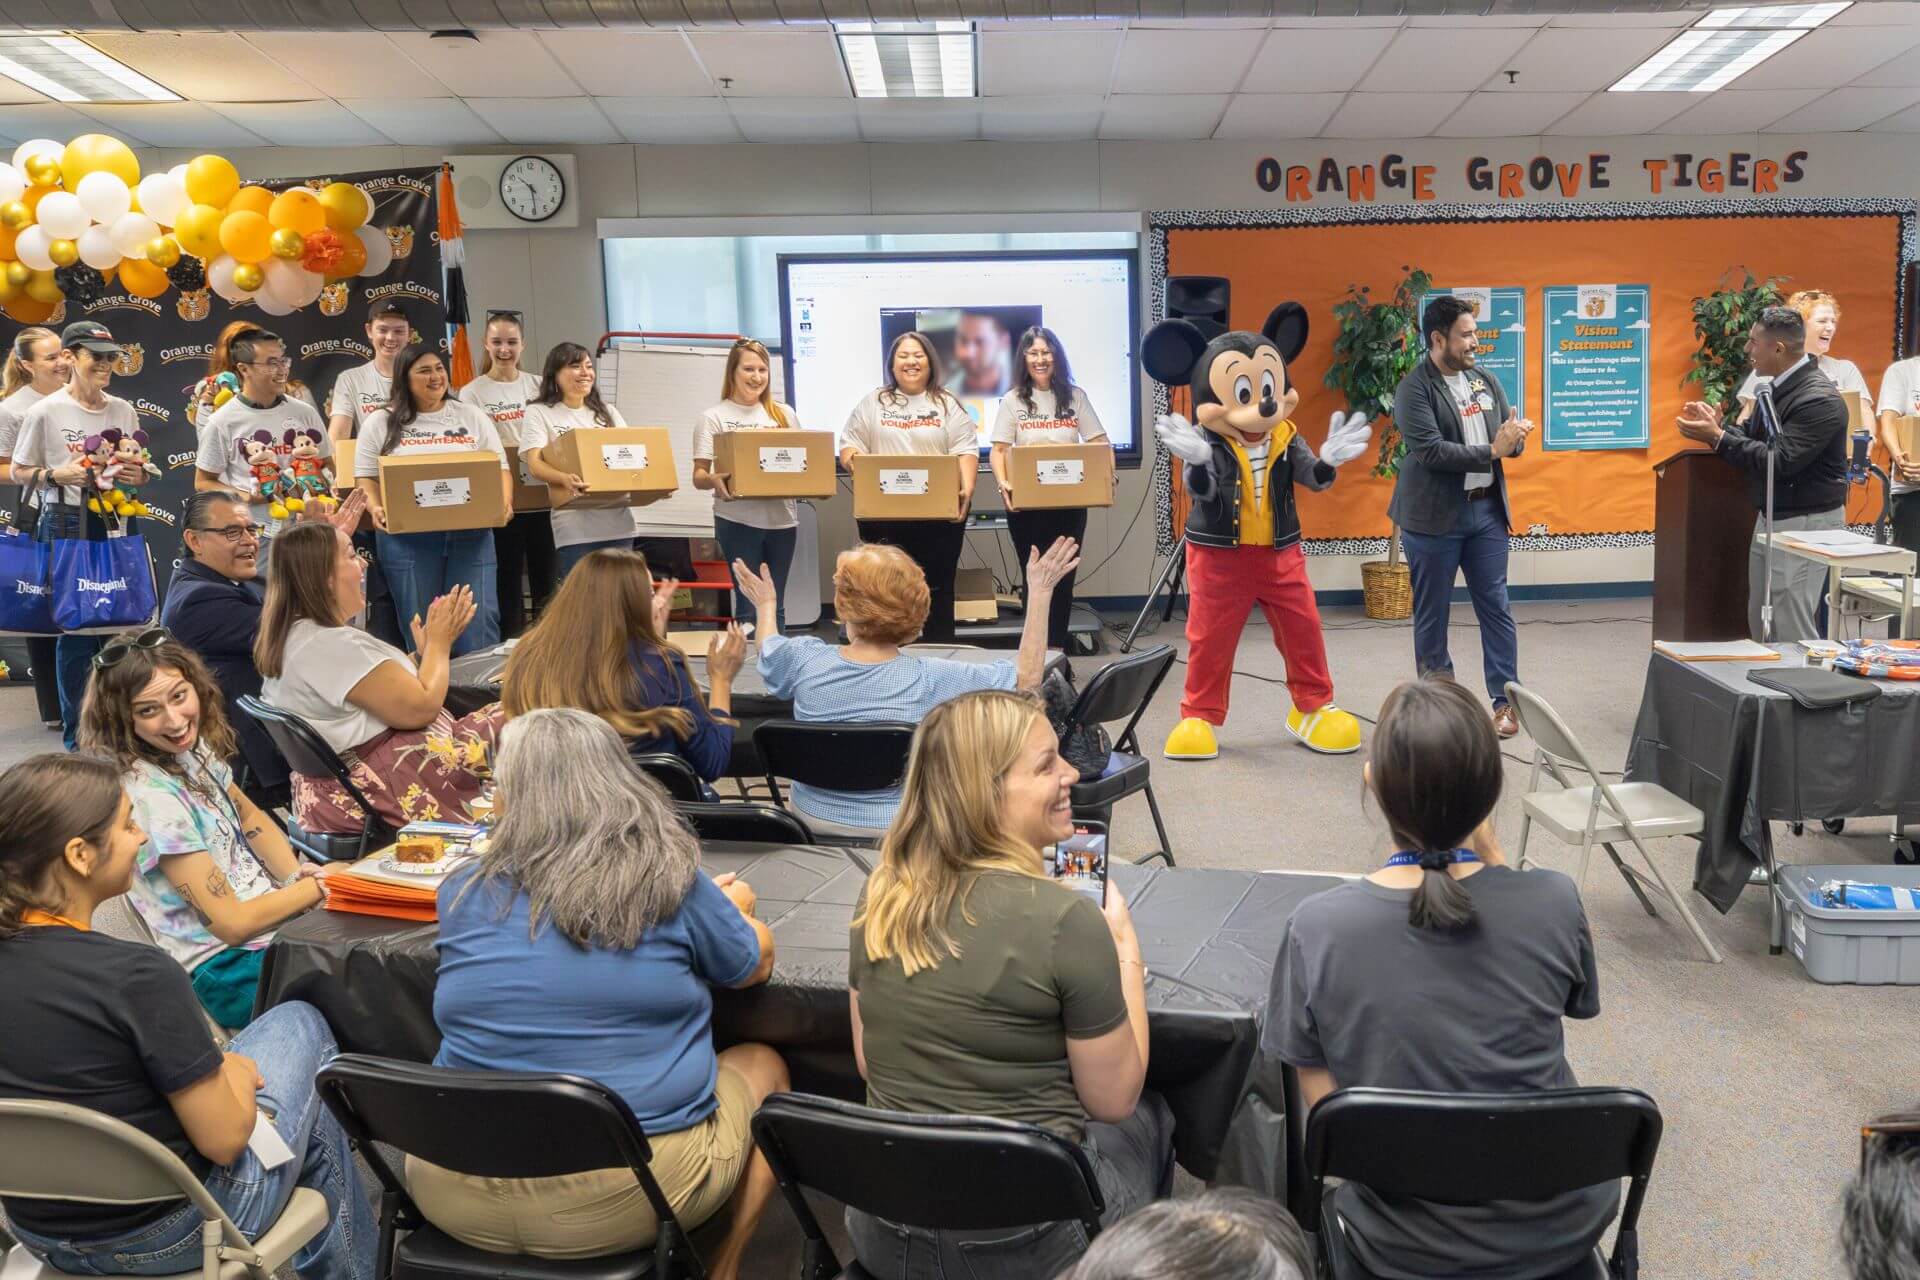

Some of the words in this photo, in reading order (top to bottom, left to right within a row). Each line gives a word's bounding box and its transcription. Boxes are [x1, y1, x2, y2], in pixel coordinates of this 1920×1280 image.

[397, 174, 432, 194] Grove
[1255, 154, 1438, 202] ORANGE
[1467, 154, 1611, 199] GROVE
[1643, 151, 1809, 194] TIGERS
[365, 282, 403, 299] Orange
[405, 280, 440, 301] Grove
[128, 293, 162, 313] Grove
[1575, 324, 1619, 337] Vision
[160, 344, 202, 360] Orange
[300, 339, 341, 355] Orange
[343, 337, 374, 358] Grove
[1559, 340, 1634, 352] Statement
[136, 398, 171, 418] Grove
[167, 450, 197, 465] Oran
[77, 576, 128, 594] Disneyland
